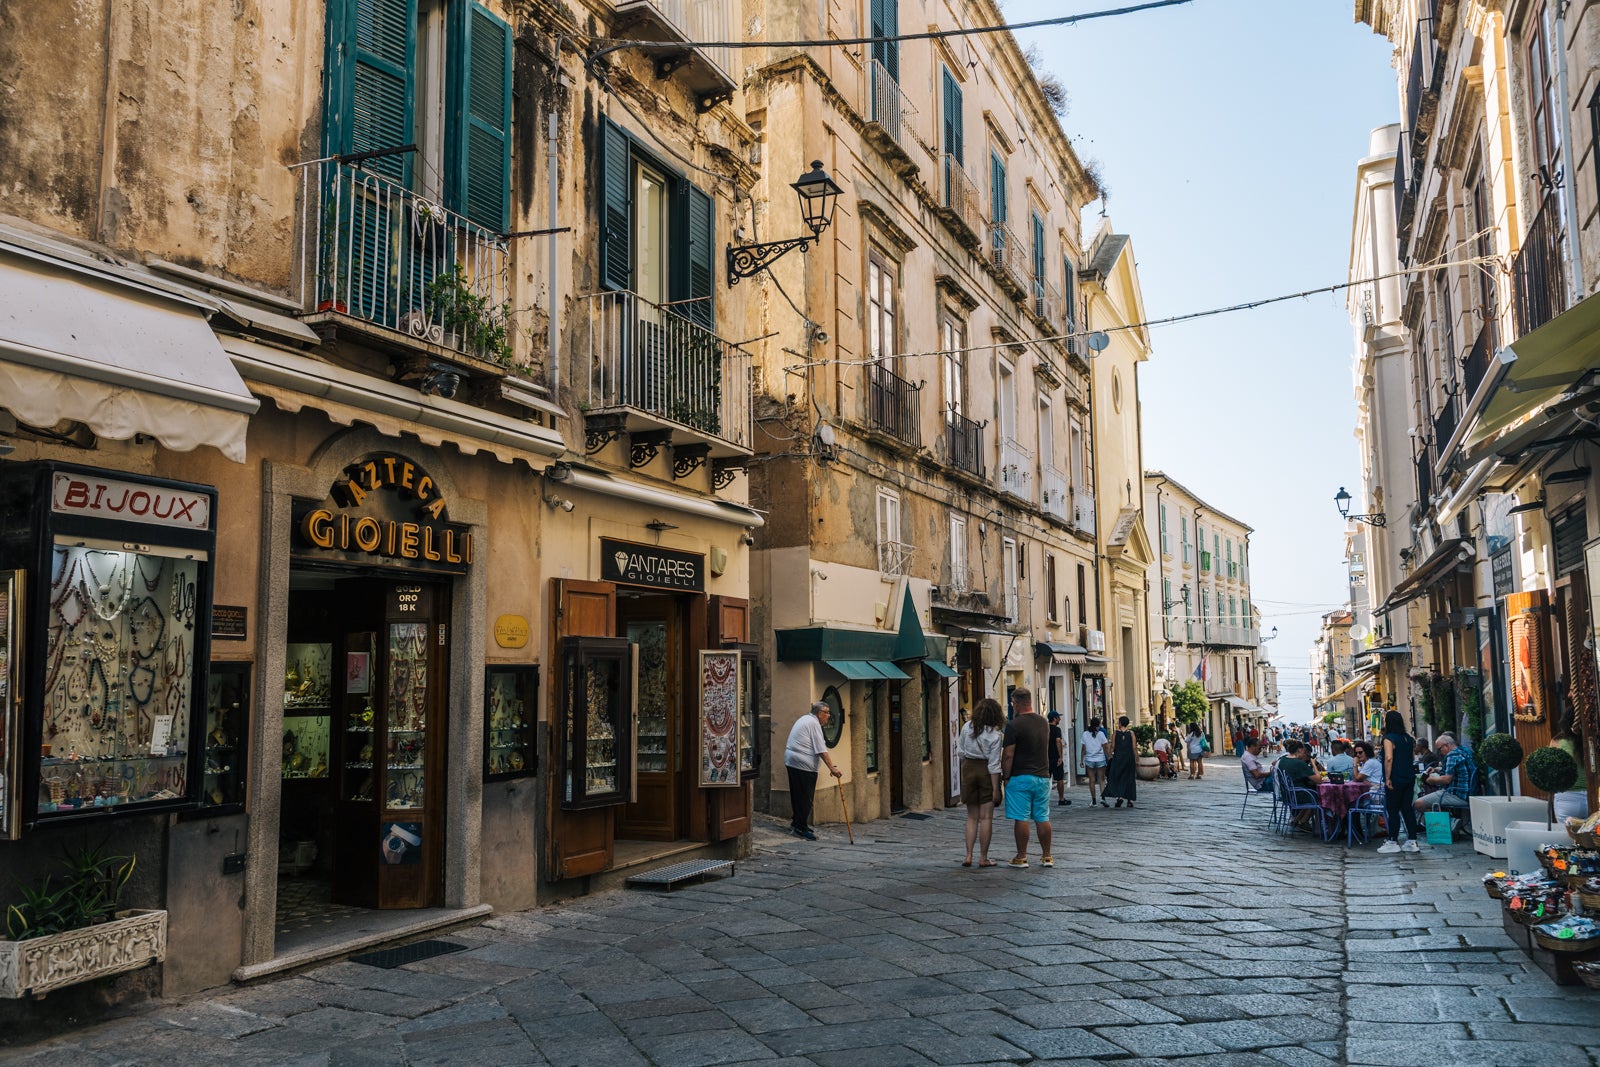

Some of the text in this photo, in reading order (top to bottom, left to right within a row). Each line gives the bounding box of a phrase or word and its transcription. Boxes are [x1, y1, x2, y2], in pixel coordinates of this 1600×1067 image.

[347, 457, 446, 520] AZTECA
[63, 480, 198, 522] BIJOUX
[308, 509, 473, 565] GIOIELLI
[628, 553, 695, 579] ANTARES
[395, 585, 421, 593] GOLD
[628, 572, 695, 586] GIOIELLI
[398, 594, 418, 602] ORO
[398, 603, 416, 611] 18 K
